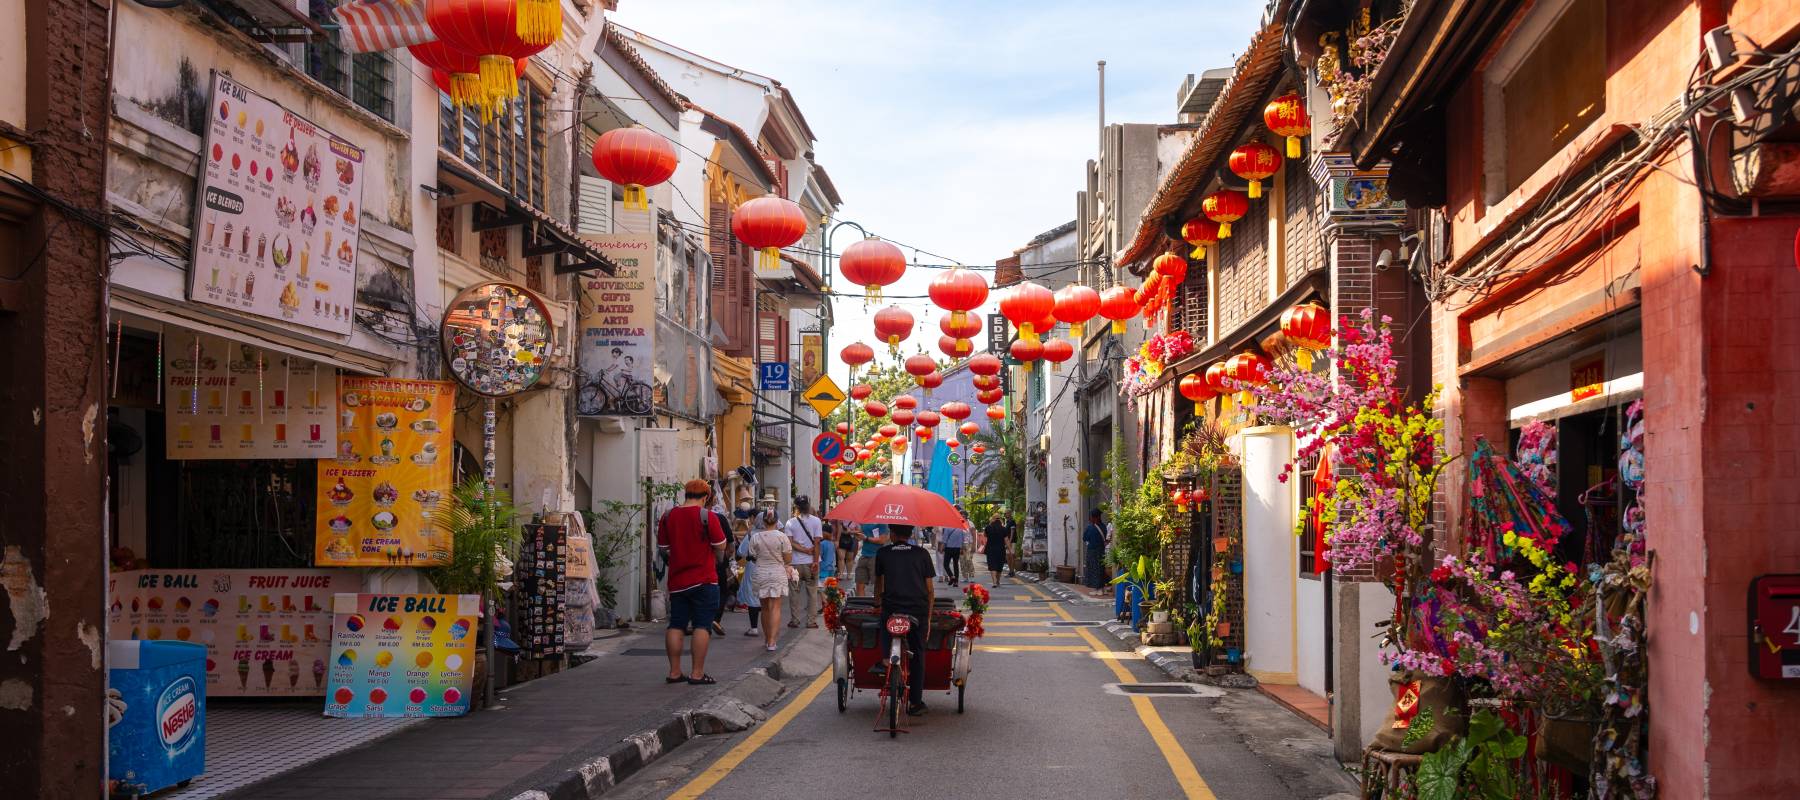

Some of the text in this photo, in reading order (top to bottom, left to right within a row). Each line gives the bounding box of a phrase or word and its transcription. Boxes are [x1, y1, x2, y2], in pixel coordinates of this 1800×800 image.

[219, 79, 248, 105] ICE BALL
[282, 111, 316, 138] ICE DESSERT
[206, 191, 244, 213] ICE BLENDED
[587, 281, 645, 290] SOUVENIRS
[600, 293, 631, 302] GIFTS
[597, 304, 634, 314] BATIKS
[602, 315, 629, 325] ARTS
[586, 328, 645, 337] SWIMWEAR
[595, 339, 609, 347] and
[765, 364, 785, 379] 19
[170, 376, 238, 387] FRUIT JUICE
[344, 379, 366, 391] ALL
[369, 380, 402, 392] STAR
[406, 382, 436, 393] CAFE
[844, 451, 854, 459] 40
[326, 469, 377, 479] ICE DESSERT
[362, 538, 401, 546] ICE CREAM
[361, 546, 381, 554] CONE
[417, 551, 428, 560] RM
[138, 574, 199, 589] ICE BALL
[249, 575, 332, 589] FRUIT JUICE
[369, 596, 446, 613] ICE BALL
[337, 632, 366, 640] Rainbow
[233, 650, 293, 661] ICE CREAM
[368, 670, 391, 680] Mango
[406, 670, 430, 680] Orange
[172, 682, 190, 698] CREAM
[328, 704, 348, 713] Grape
[163, 699, 195, 739] Nestlé
